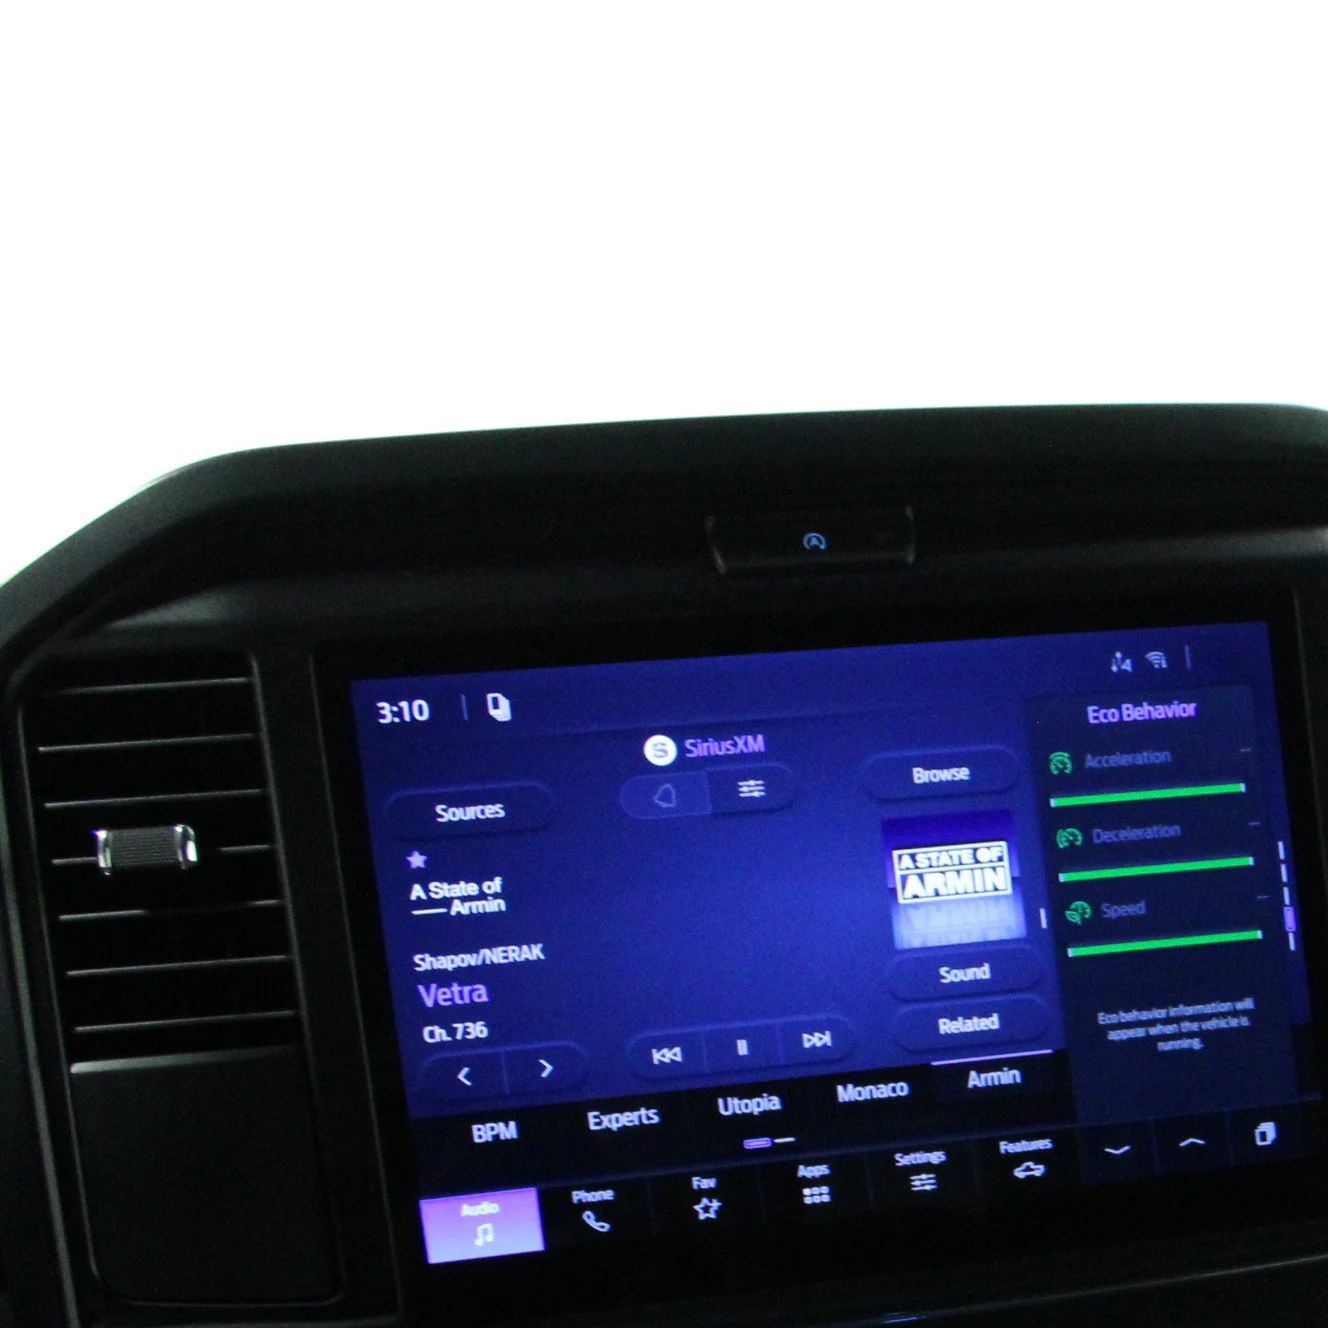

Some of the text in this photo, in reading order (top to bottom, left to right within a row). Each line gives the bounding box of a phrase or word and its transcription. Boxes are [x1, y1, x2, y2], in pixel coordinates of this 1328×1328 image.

[376, 699, 430, 724] 3:10
[1087, 701, 1198, 724] Eco Behavior
[685, 734, 765, 758] SiriusXM
[1084, 749, 1172, 769] Acceleration
[912, 766, 970, 784] Browse
[435, 801, 505, 824] Sources
[1092, 824, 1182, 844] Deceleration
[900, 846, 1003, 870] A STATE OF
[410, 876, 502, 901] A State of
[903, 866, 1007, 899] ARMIN
[450, 896, 506, 916] Armin
[1101, 900, 1147, 919] Speed
[413, 943, 545, 972] Shapov/NERAK
[939, 962, 991, 984] Sound
[417, 982, 489, 1008] Vetra
[422, 1021, 489, 1044] Ch. 736
[938, 1012, 1000, 1035] Related
[472, 1067, 1022, 1143] BPM Experts Utopia Monaco Armin
[460, 1137, 1053, 1218] Audio Phone Fav Apps Settings Features
